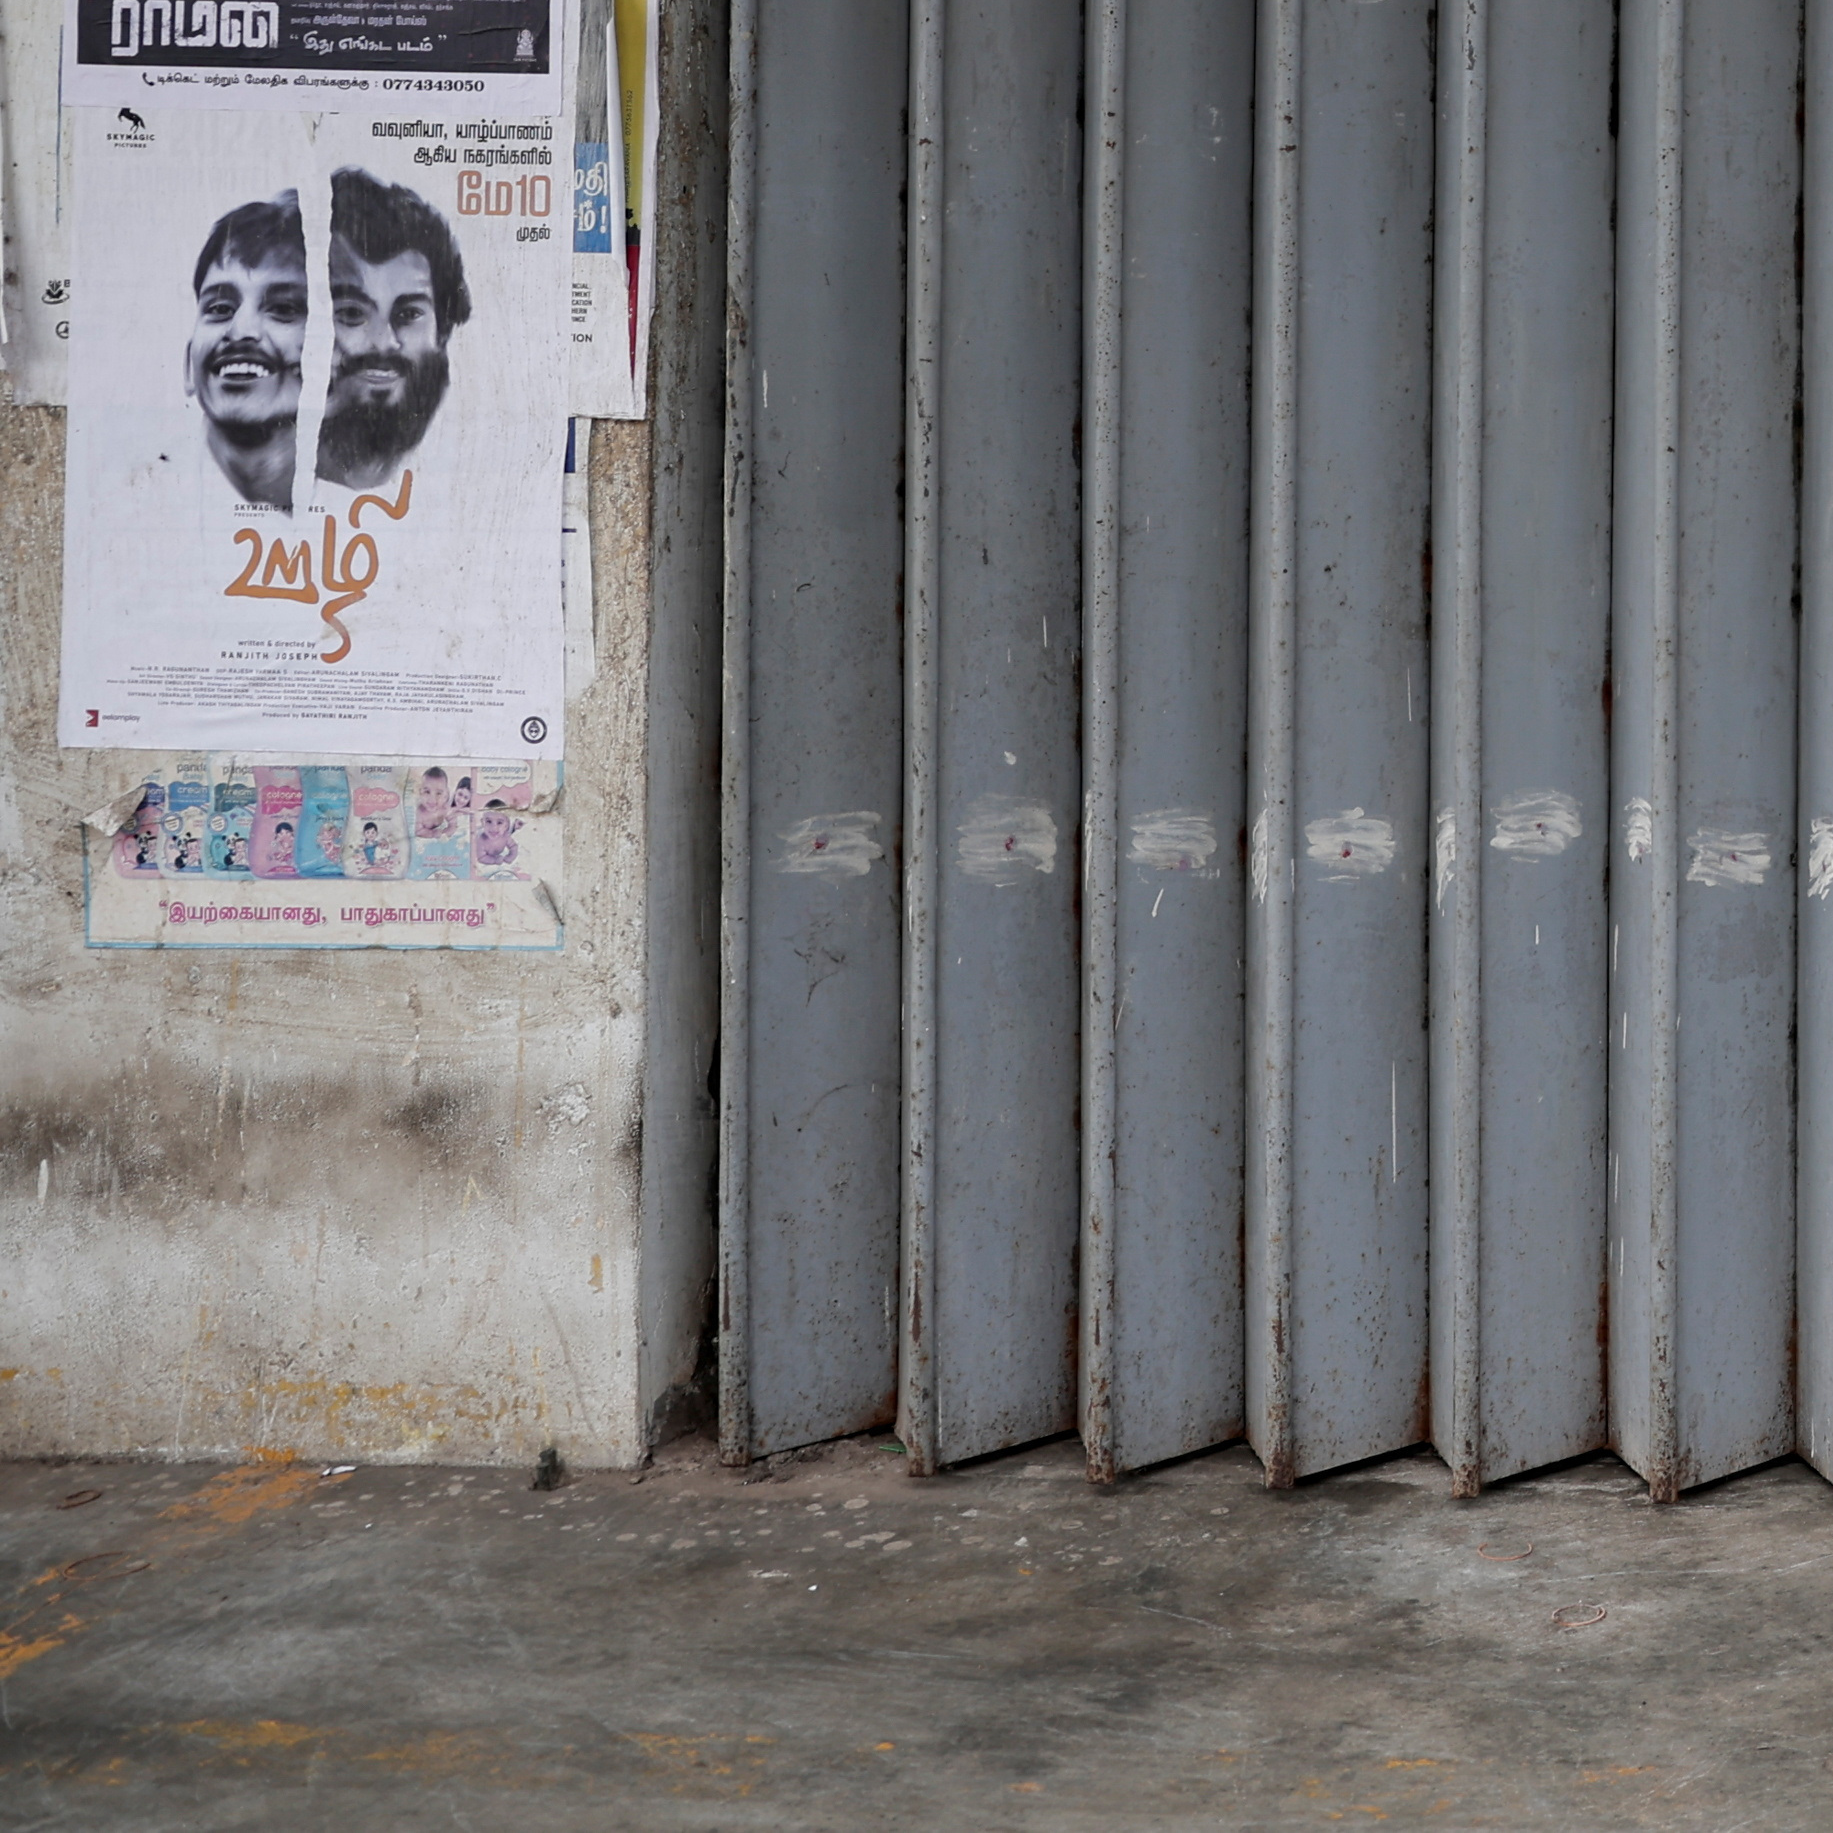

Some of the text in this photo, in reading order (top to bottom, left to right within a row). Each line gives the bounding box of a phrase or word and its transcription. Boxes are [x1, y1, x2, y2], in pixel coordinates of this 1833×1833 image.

[204, 72, 241, 87] மற்றும்
[382, 78, 486, 93] 0774343050
[371, 118, 553, 143] வவுனியா, யாழ்ப்பாணம்
[106, 133, 156, 142] SKYMAGIC
[414, 144, 553, 168] ஆகிய நகரங்களில்
[515, 224, 551, 243] முதல்
[233, 503, 279, 513] SKYMAGIC
[237, 639, 266, 648] written
[274, 640, 305, 649] directed
[306, 641, 317, 650] by
[220, 651, 319, 662] RANJITH JOSEPH
[177, 786, 209, 796] cream
[266, 790, 303, 800] cologne
[358, 793, 395, 802] cologne
